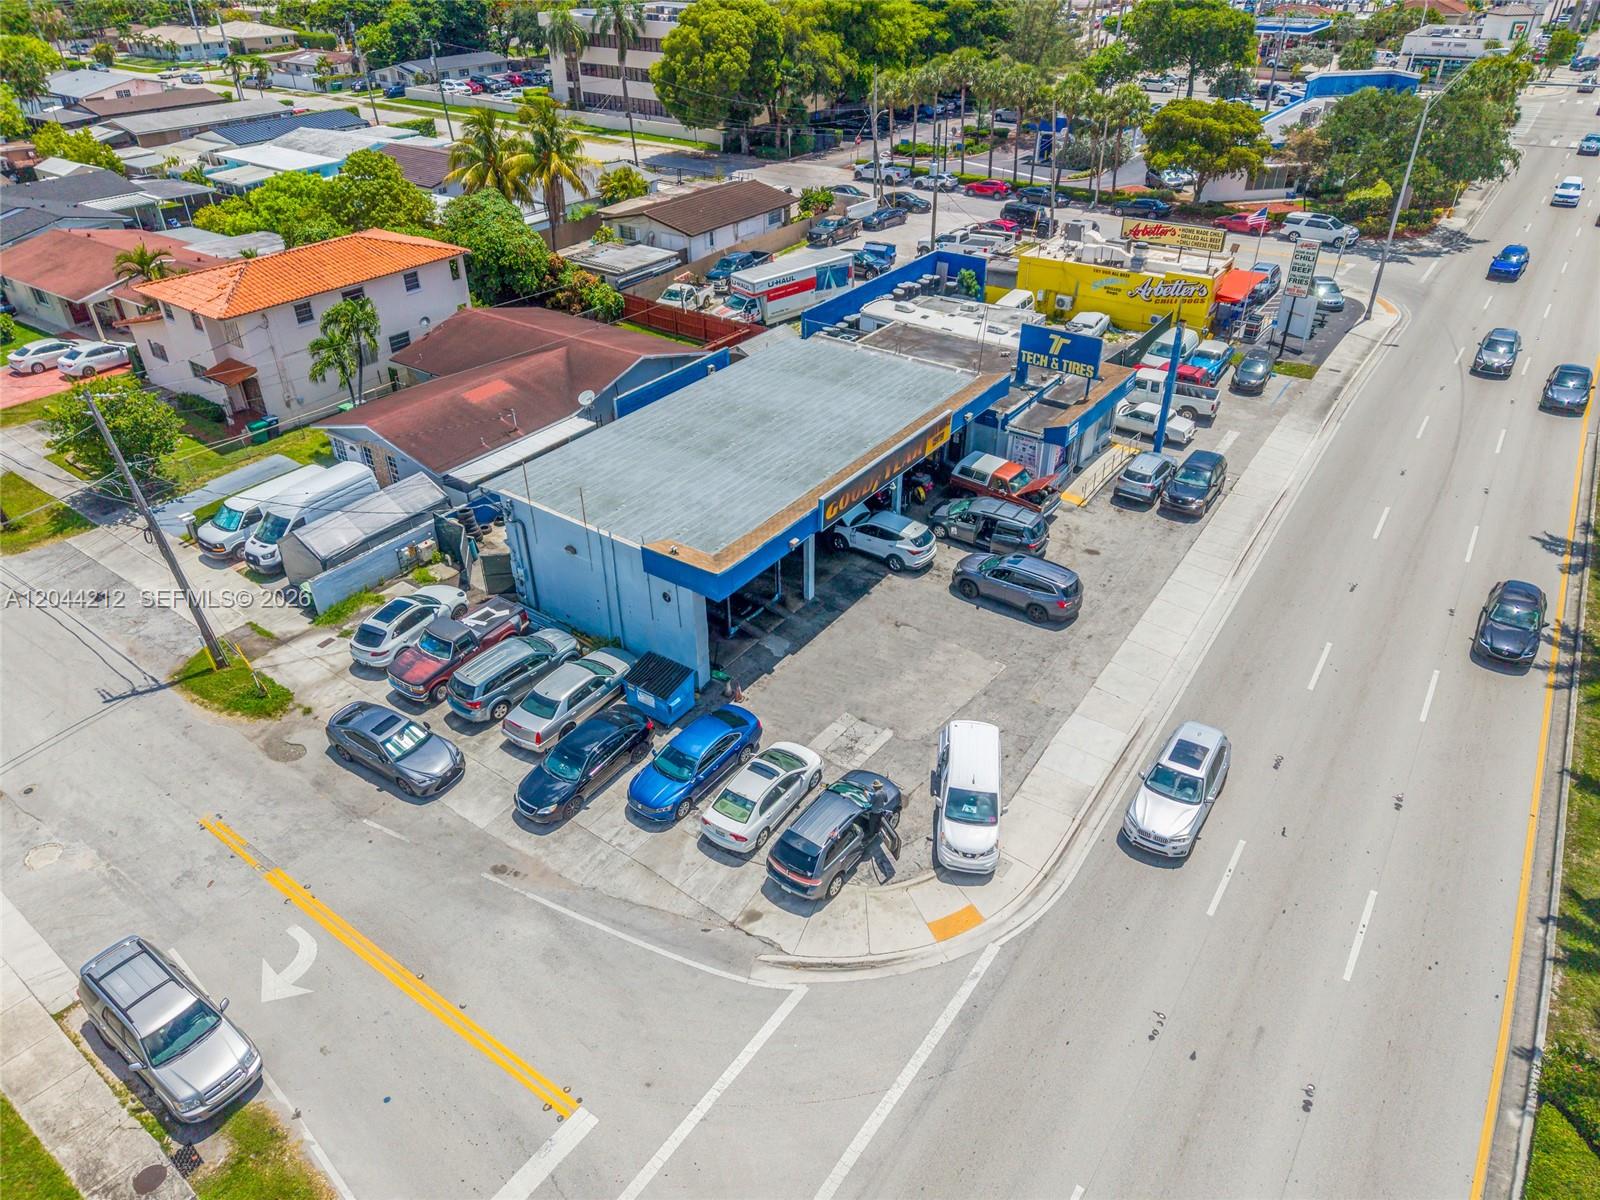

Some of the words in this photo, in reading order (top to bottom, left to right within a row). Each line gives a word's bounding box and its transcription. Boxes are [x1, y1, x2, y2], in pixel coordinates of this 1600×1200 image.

[1124, 222, 1177, 239] Arbetter's
[1294, 254, 1316, 262] CHILI
[1291, 266, 1312, 274] BEEF
[768, 276, 796, 287] U-HAUL
[1288, 277, 1309, 286] FRIES
[1128, 277, 1208, 302] Arbetter's
[1021, 350, 1048, 367] TECH
[1051, 357, 1059, 369] &
[1062, 359, 1095, 378] TIRES
